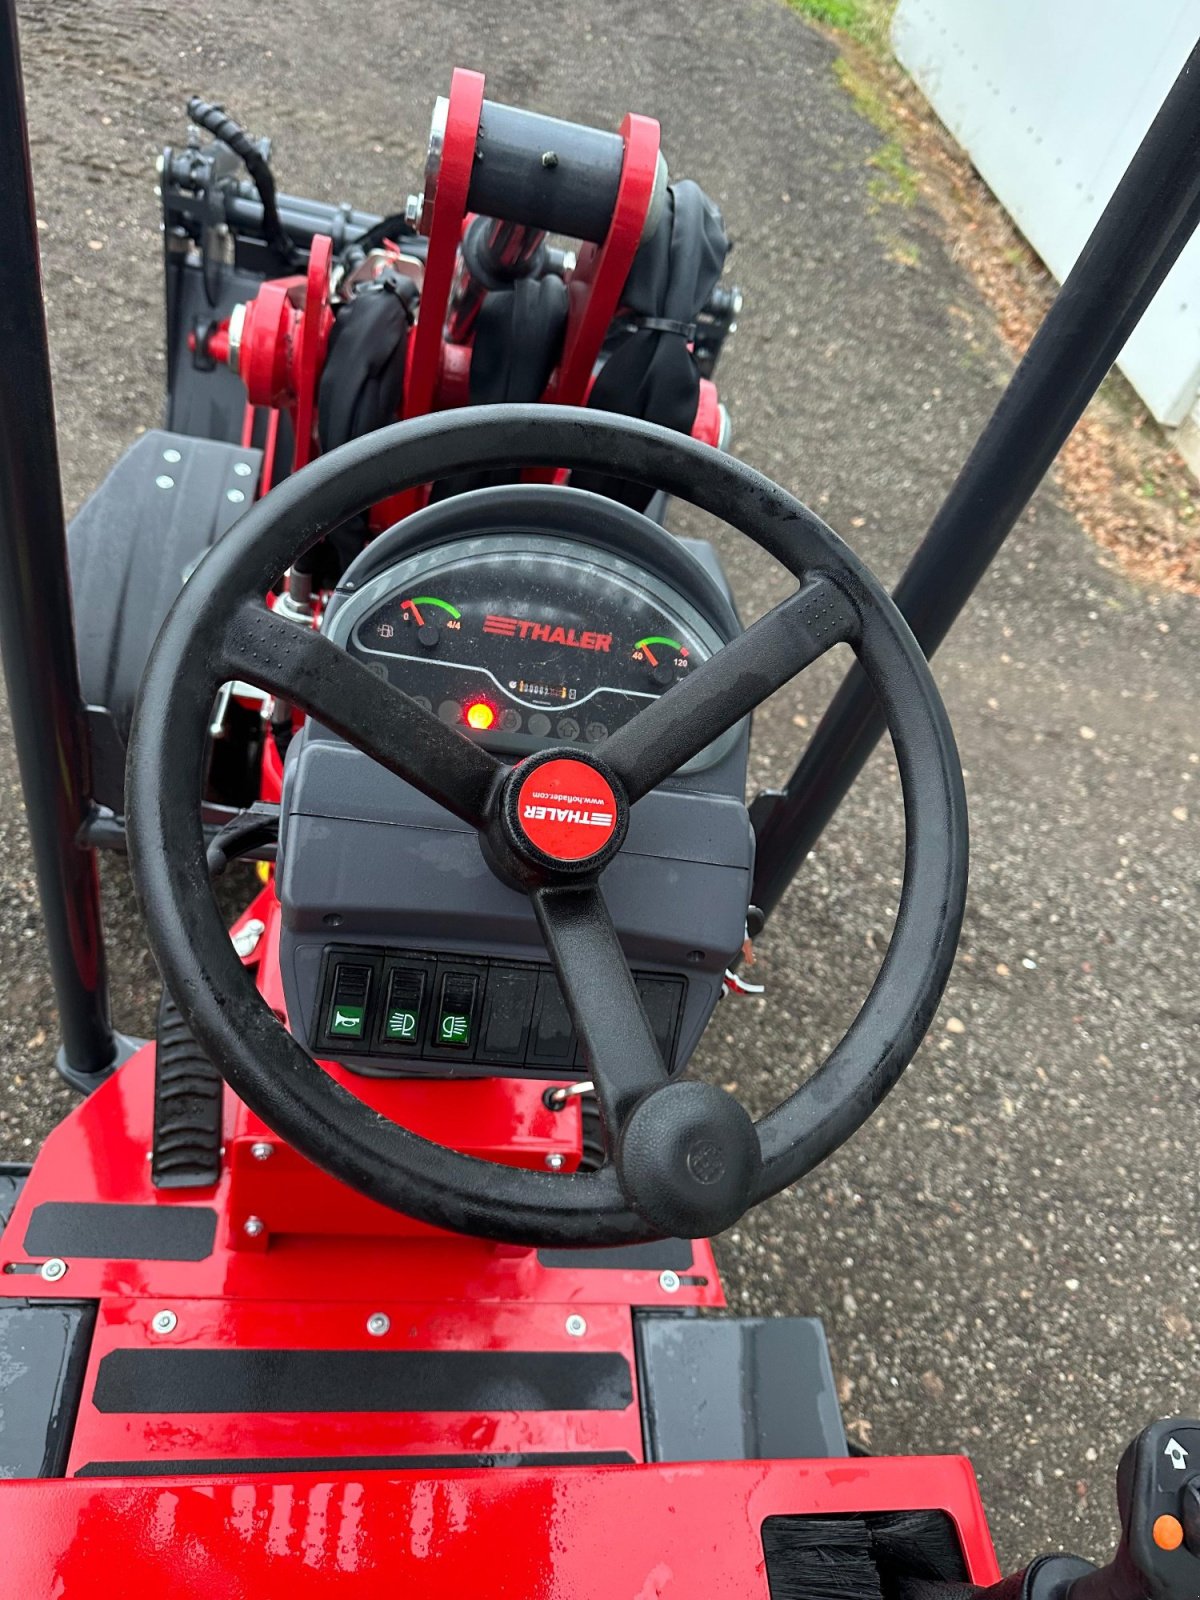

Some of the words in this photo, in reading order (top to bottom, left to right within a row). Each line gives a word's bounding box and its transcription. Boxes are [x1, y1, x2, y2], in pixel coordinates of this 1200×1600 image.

[403, 612, 409, 621] 0
[446, 620, 461, 630] 4/4
[516, 619, 613, 652] THALER
[632, 650, 644, 660] 40
[673, 658, 688, 667] 120
[532, 791, 605, 806] www.hoflader.com
[523, 804, 592, 825] THALER
